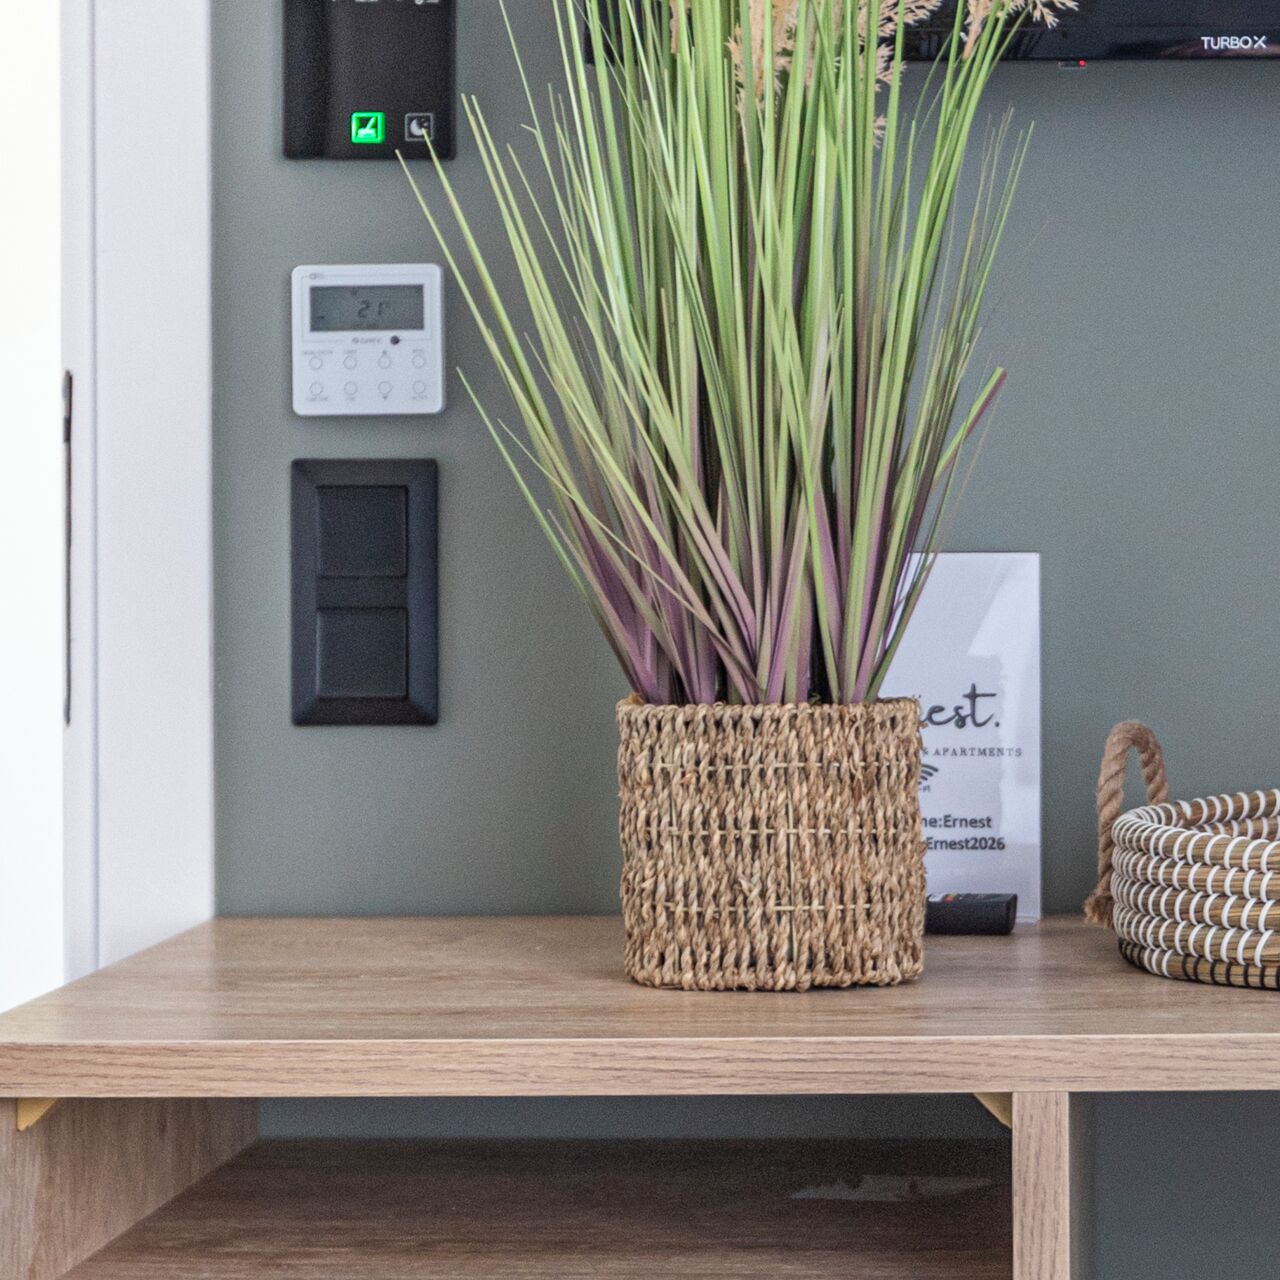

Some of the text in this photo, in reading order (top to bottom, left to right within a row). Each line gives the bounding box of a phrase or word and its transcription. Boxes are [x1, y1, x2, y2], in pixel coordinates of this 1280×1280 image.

[921, 683, 1000, 729] est.
[933, 746, 1023, 757] APARTMENTS
[926, 836, 1006, 851] Ernest2026
